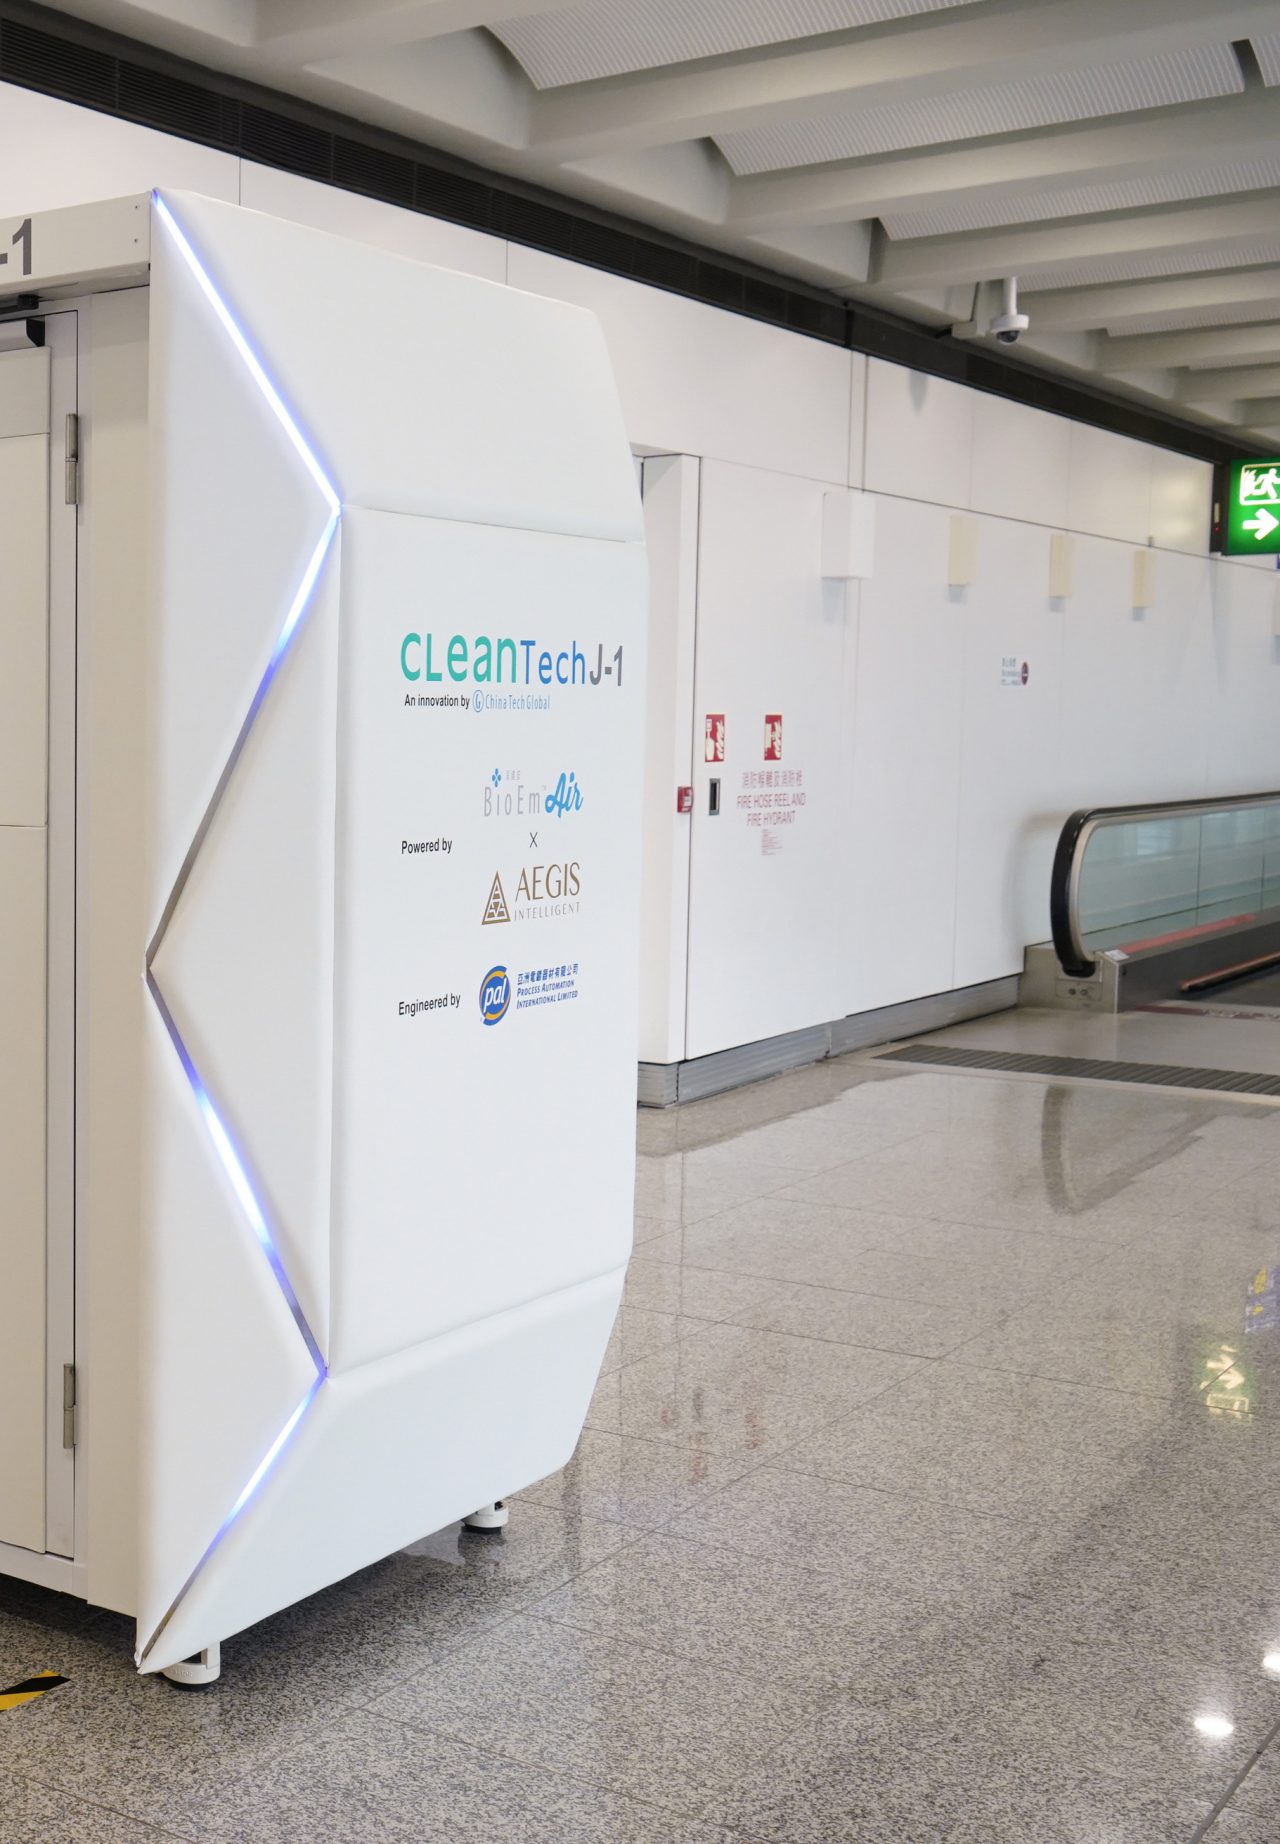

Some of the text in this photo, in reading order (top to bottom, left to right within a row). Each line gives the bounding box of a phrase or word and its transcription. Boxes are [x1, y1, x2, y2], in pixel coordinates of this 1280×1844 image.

[590, 643, 623, 687] J-1
[405, 694, 415, 706] An
[418, 693, 458, 706] innovation
[461, 694, 470, 710] by
[486, 693, 507, 709] China
[508, 694, 525, 709] Tech
[526, 693, 551, 710] Global
[544, 771, 583, 818] Air
[737, 794, 752, 809] FIRE
[747, 811, 762, 827] FIRE
[401, 837, 453, 854] Powered by
[515, 862, 580, 902] AEGIS
[514, 902, 580, 921] INTELLIGENT
[483, 977, 508, 1014] pal
[517, 979, 575, 998] PROCESS AUTOMATION
[398, 992, 461, 1017] Engineered by
[516, 990, 578, 1009] INTERNATIONAL LIMITED
